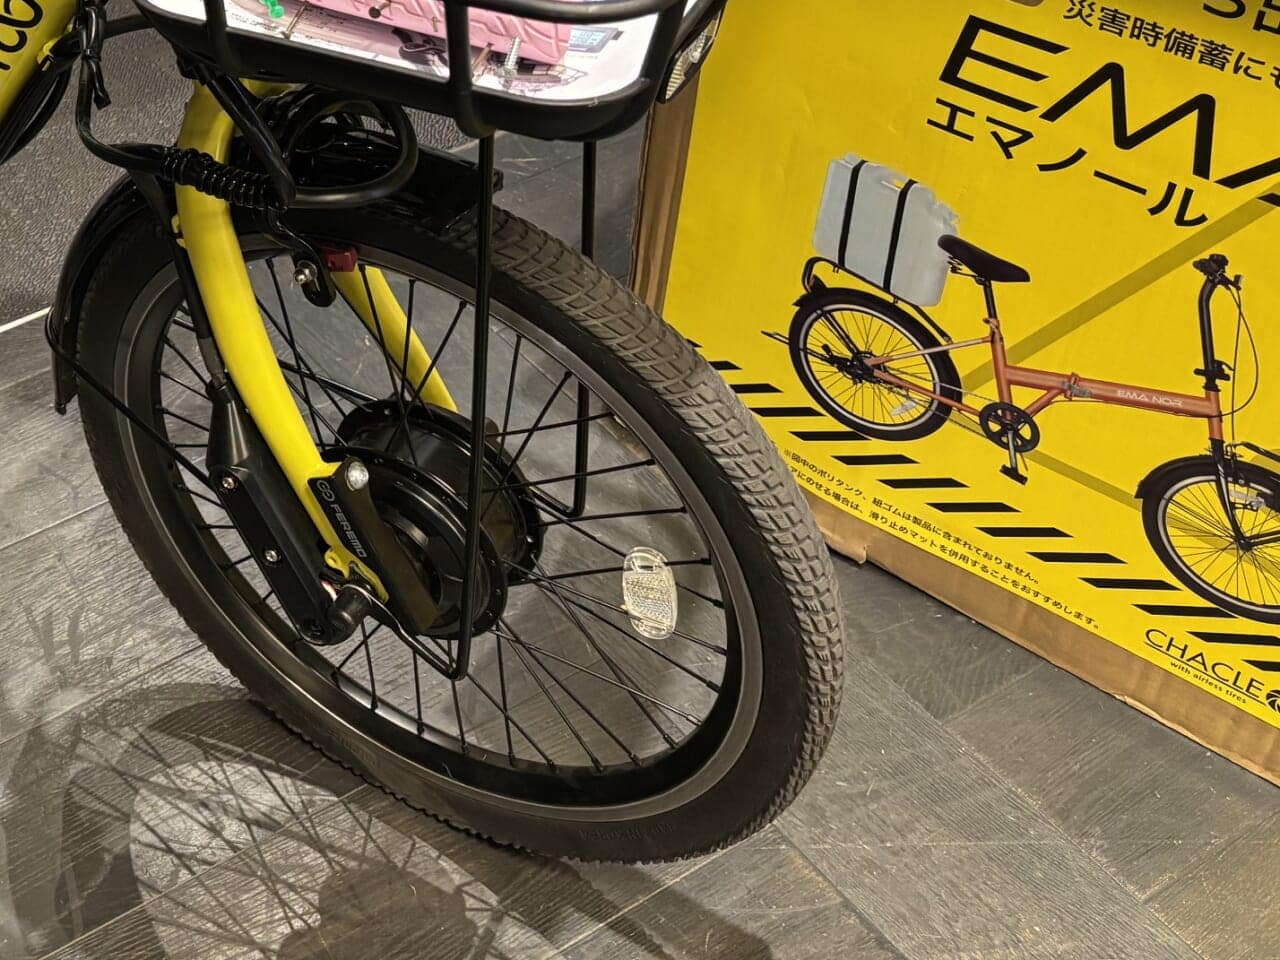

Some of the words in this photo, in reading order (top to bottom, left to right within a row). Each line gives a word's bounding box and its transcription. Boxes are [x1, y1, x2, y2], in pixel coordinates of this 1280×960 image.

[926, 96, 1209, 230] エマノール
[1117, 389, 1150, 402] EMA
[1151, 395, 1184, 408] NOR
[329, 502, 368, 559] FEREMO
[1144, 628, 1265, 699] CHACLE
[1169, 660, 1191, 676] with
[1192, 672, 1224, 693] airless
[1225, 689, 1247, 705] tires
